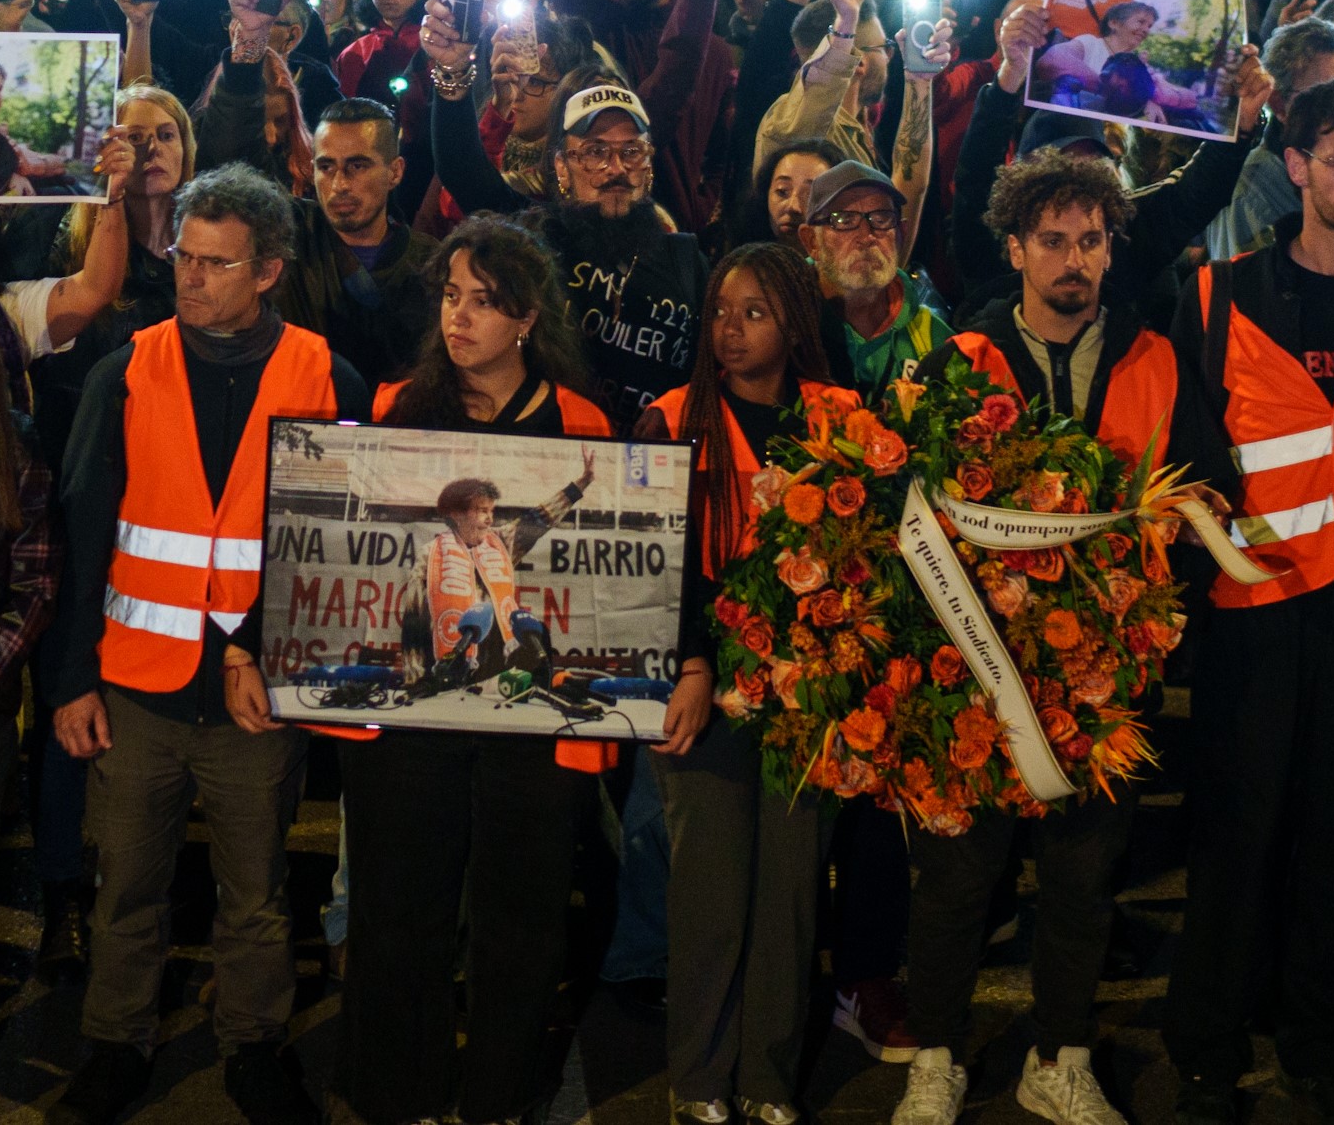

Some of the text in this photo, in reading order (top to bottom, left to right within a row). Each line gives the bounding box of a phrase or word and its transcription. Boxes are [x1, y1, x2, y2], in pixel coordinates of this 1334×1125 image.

[961, 516, 989, 530] por
[994, 522, 1074, 538] luchando
[347, 530, 416, 568] VIDA
[550, 539, 665, 577] BARRIO
[906, 514, 1003, 684] Te quiere, tu Sindicato.
